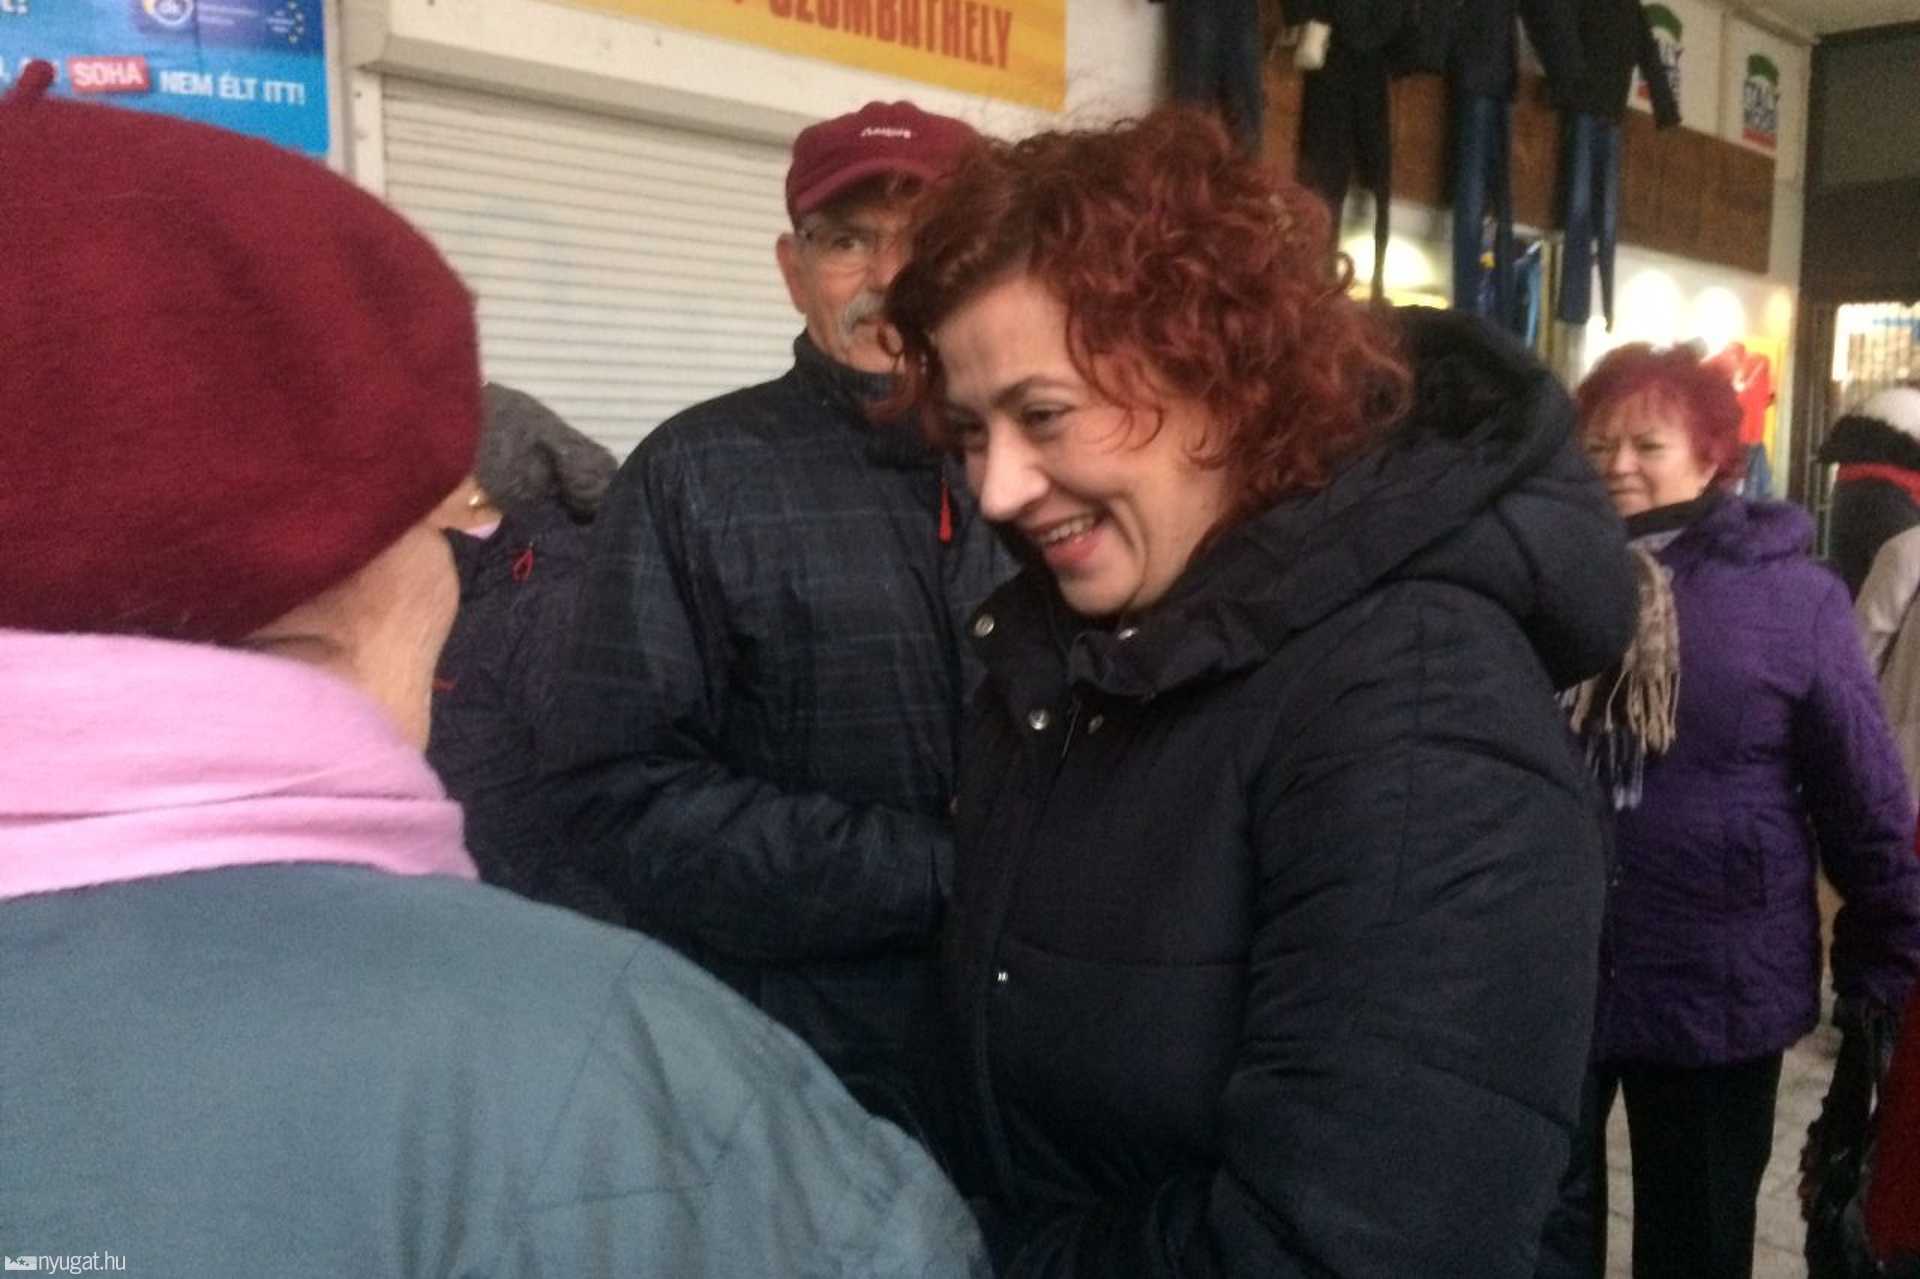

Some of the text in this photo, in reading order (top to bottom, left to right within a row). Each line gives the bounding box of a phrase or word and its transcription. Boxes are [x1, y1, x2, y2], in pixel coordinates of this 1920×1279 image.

[73, 61, 145, 87] SOHA
[160, 70, 213, 97] NEM
[219, 70, 258, 101] ÉLT
